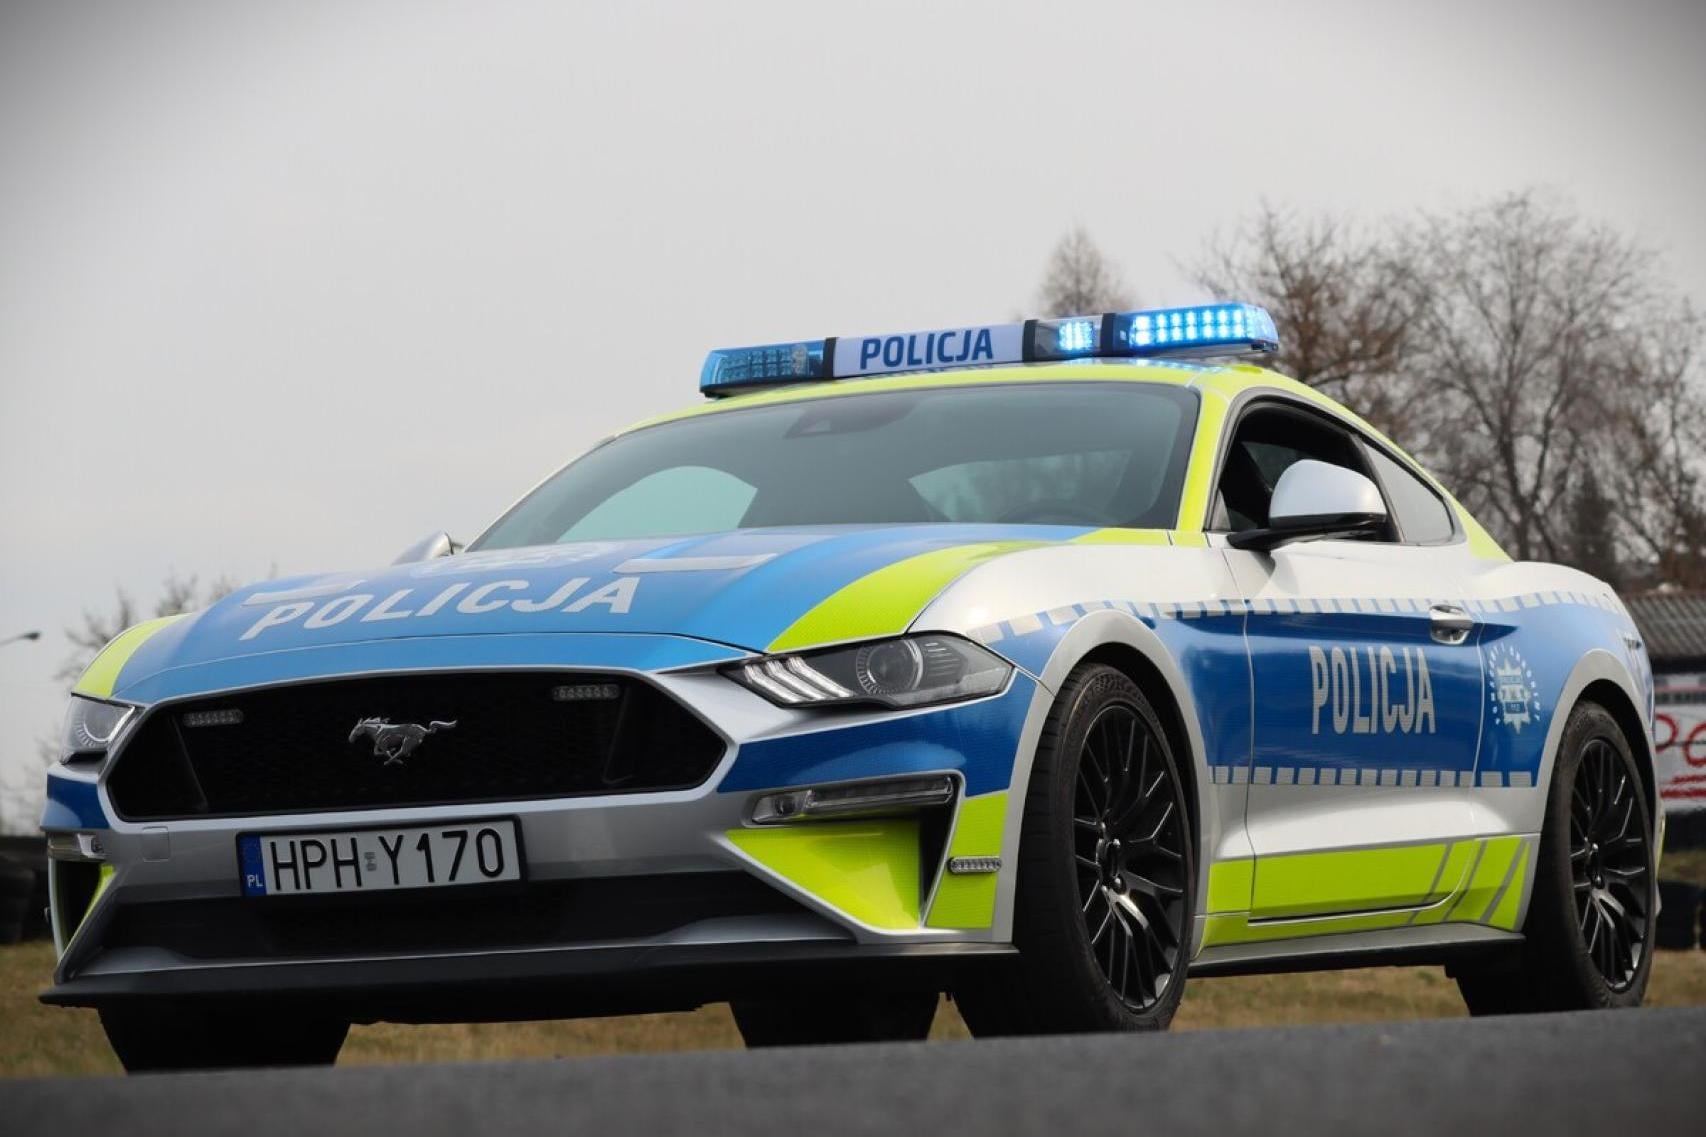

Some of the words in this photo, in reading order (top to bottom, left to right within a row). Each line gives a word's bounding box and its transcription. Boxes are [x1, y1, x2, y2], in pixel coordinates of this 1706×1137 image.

[861, 328, 993, 370] POLICJA
[240, 577, 640, 641] POLICJA
[1309, 646, 1436, 735] POLICJA
[247, 875, 263, 887] PL
[270, 837, 362, 890] HPH
[379, 828, 504, 885] Y170
